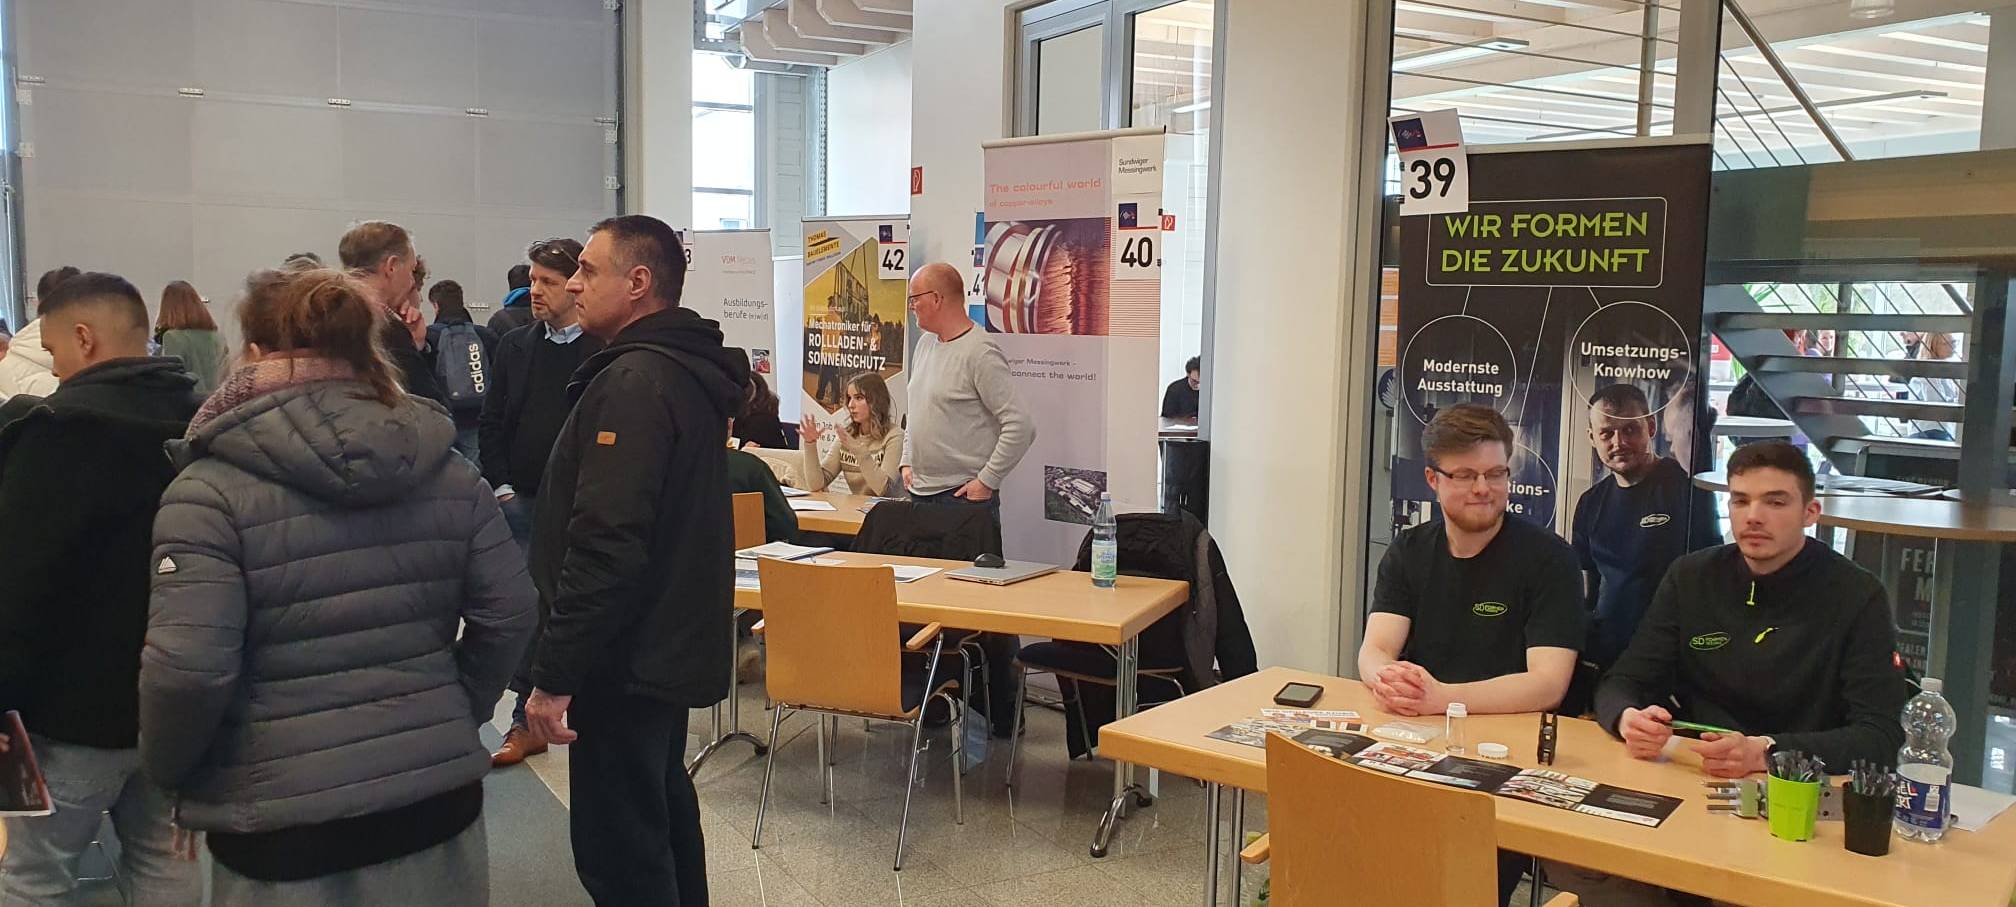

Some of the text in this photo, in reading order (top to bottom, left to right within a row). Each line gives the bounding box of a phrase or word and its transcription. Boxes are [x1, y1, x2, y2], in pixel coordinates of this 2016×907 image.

[991, 178, 1101, 193] The colourful world
[1410, 157, 1456, 199] 39
[1445, 212, 1648, 238] WIR FORMEN
[684, 248, 692, 264] 3
[882, 249, 905, 271] 42
[1120, 237, 1153, 268] 40
[1441, 248, 1650, 272] DIE ZUKUNFT
[723, 299, 768, 309] Ausbildungs-
[724, 310, 747, 319] berufe
[808, 319, 872, 333] Mechatroniker für
[870, 337, 877, 351] &
[1581, 342, 1688, 361] Umsetzungs-
[469, 343, 485, 393] adidas
[808, 351, 886, 371] SONNENSCHUTZ
[1423, 359, 1500, 374] Modernste
[1011, 370, 1046, 378] connect
[1049, 371, 1064, 379] the
[1594, 363, 1671, 380] Knowhow
[1418, 378, 1503, 397] Ausstattung
[1507, 481, 1550, 496] tions-
[1506, 499, 1523, 514] ke
